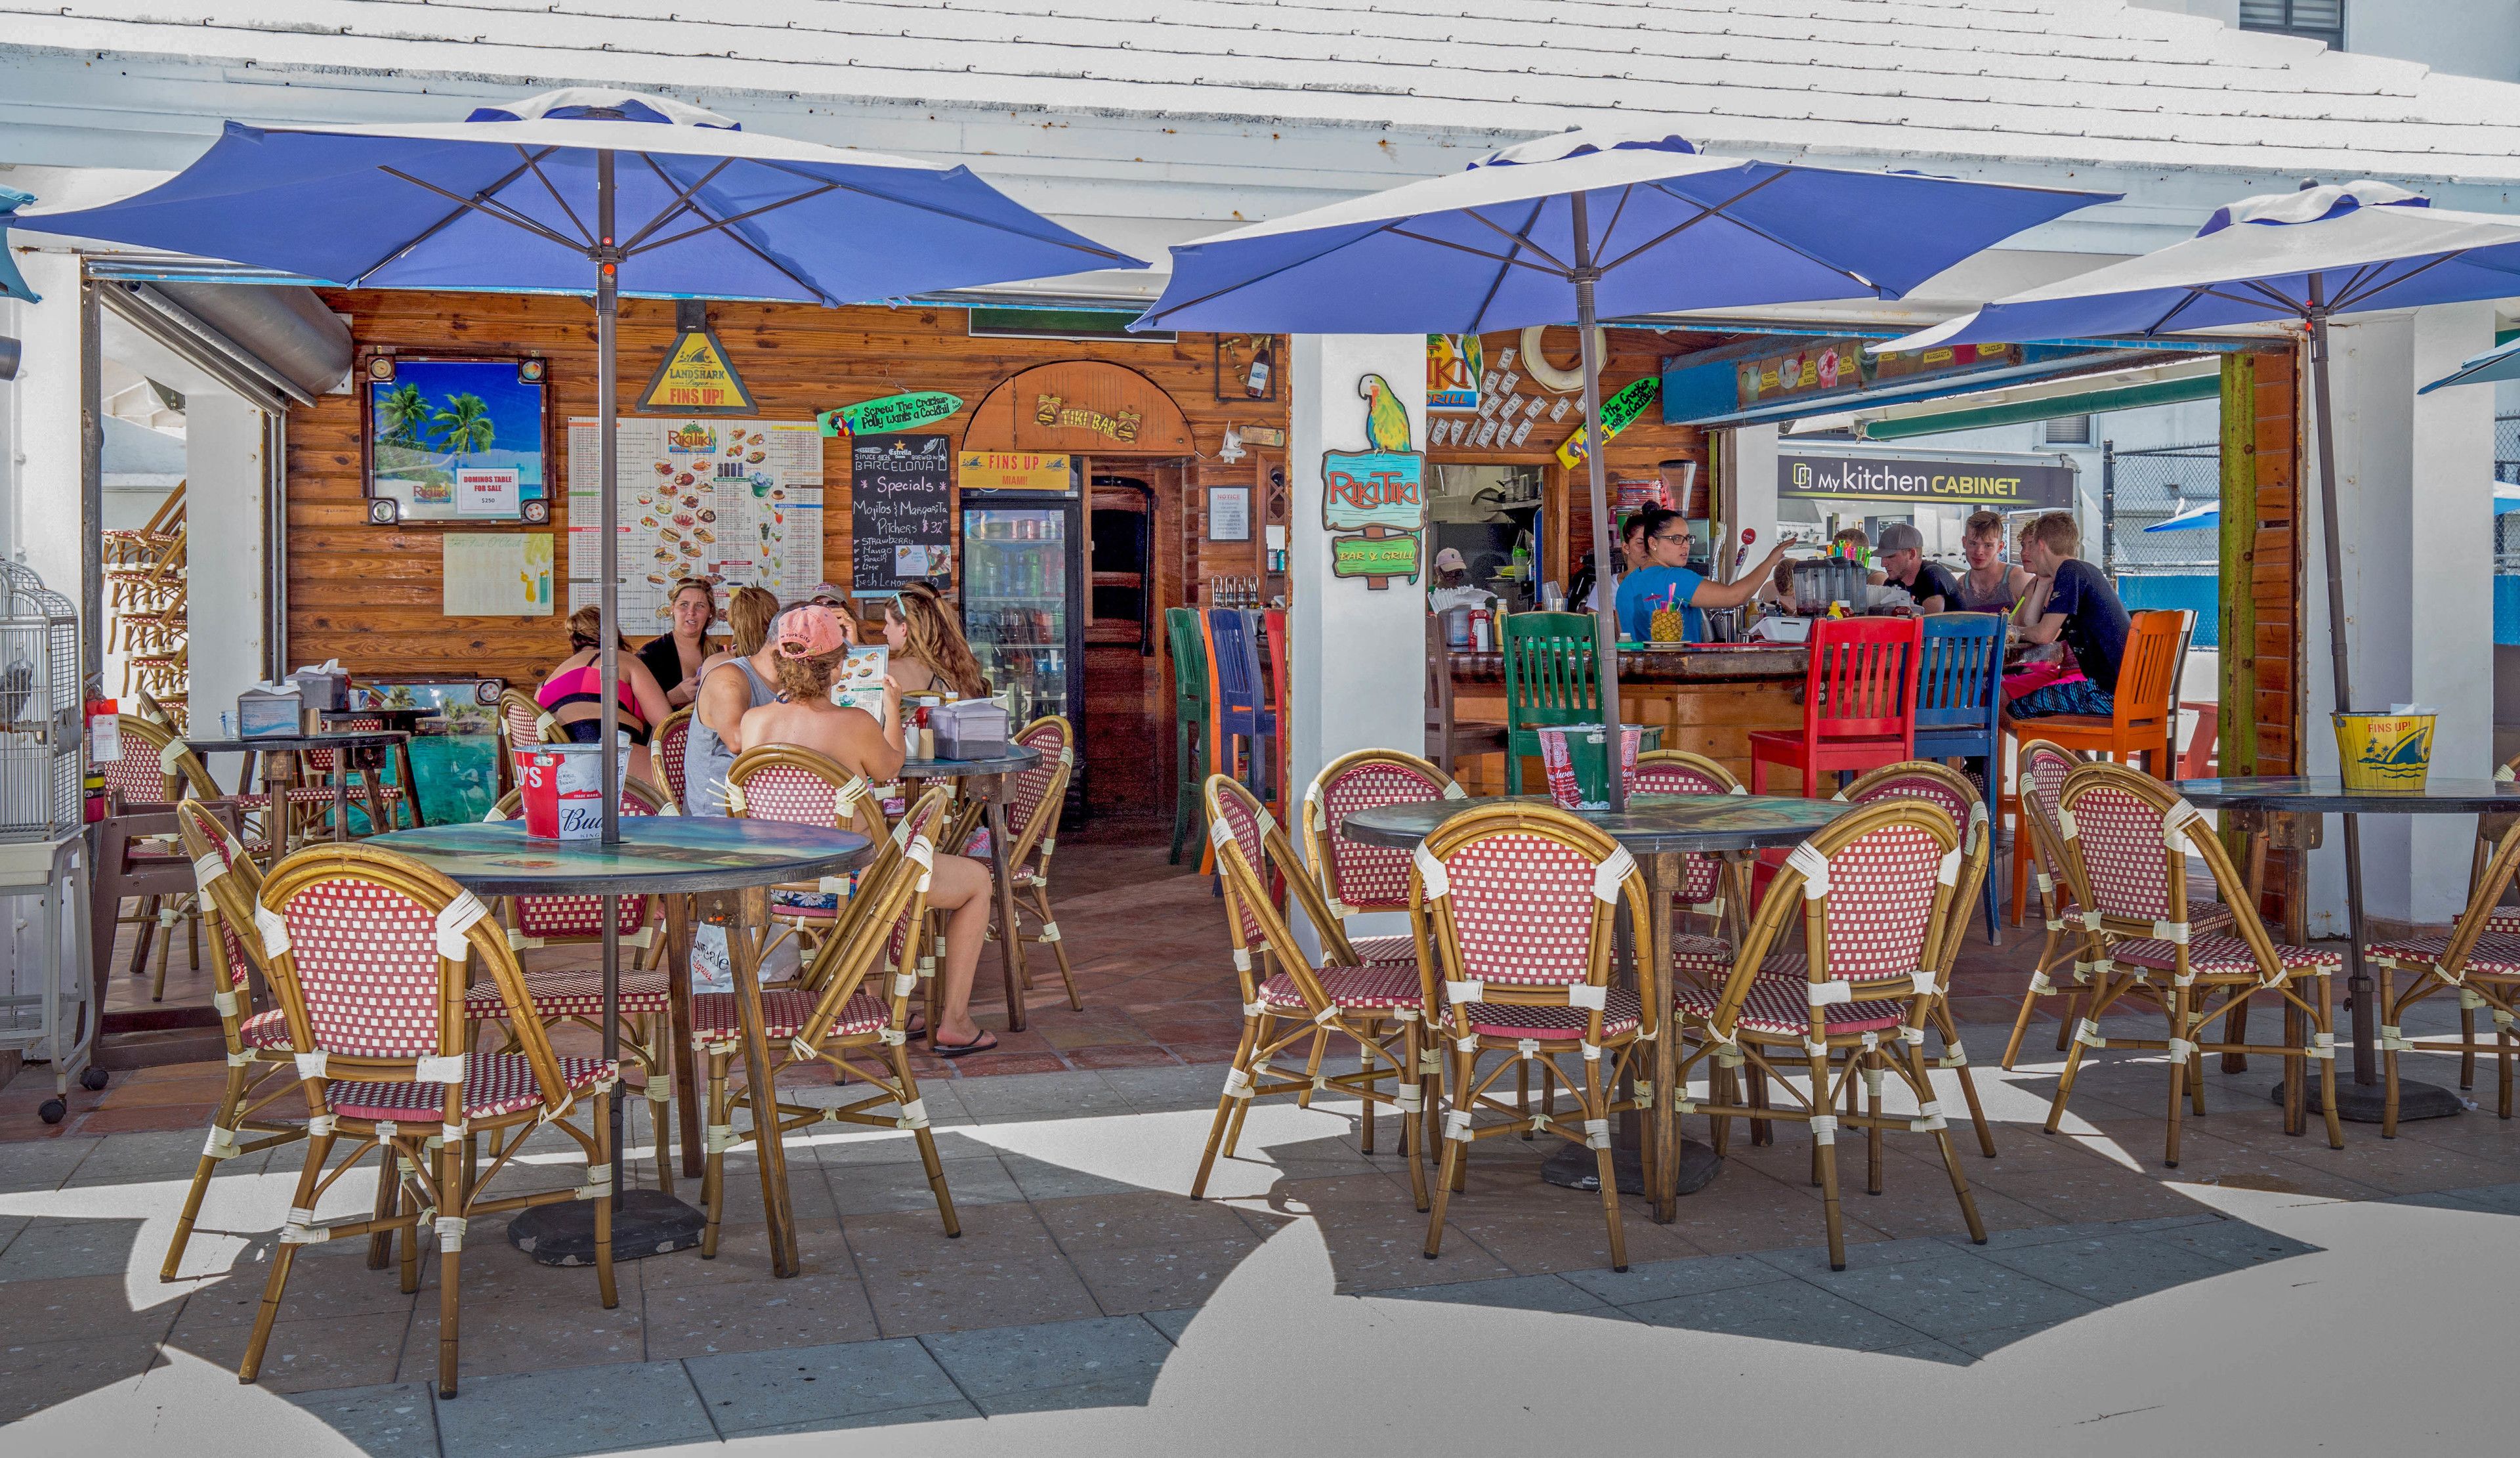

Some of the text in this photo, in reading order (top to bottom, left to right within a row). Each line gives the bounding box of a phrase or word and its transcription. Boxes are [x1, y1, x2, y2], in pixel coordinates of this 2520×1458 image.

[669, 369, 724, 379] LANDSHARK
[669, 388, 724, 405] FINS UP!
[864, 396, 948, 418] Screw The Cracker
[862, 414, 884, 429] Polly
[920, 404, 950, 418] Cocktail
[1061, 410, 1117, 437] TIKI BAR
[855, 461, 934, 471] BARCELONA
[989, 455, 1040, 471] FINS UP
[1002, 475, 1028, 485] MIAMI!
[1818, 461, 2021, 496] My kitchen CABINET
[877, 476, 934, 499] Specials
[1339, 551, 1416, 561] BAR & GRILL
[800, 634, 811, 643] City
[2367, 721, 2412, 733] FINS UP!
